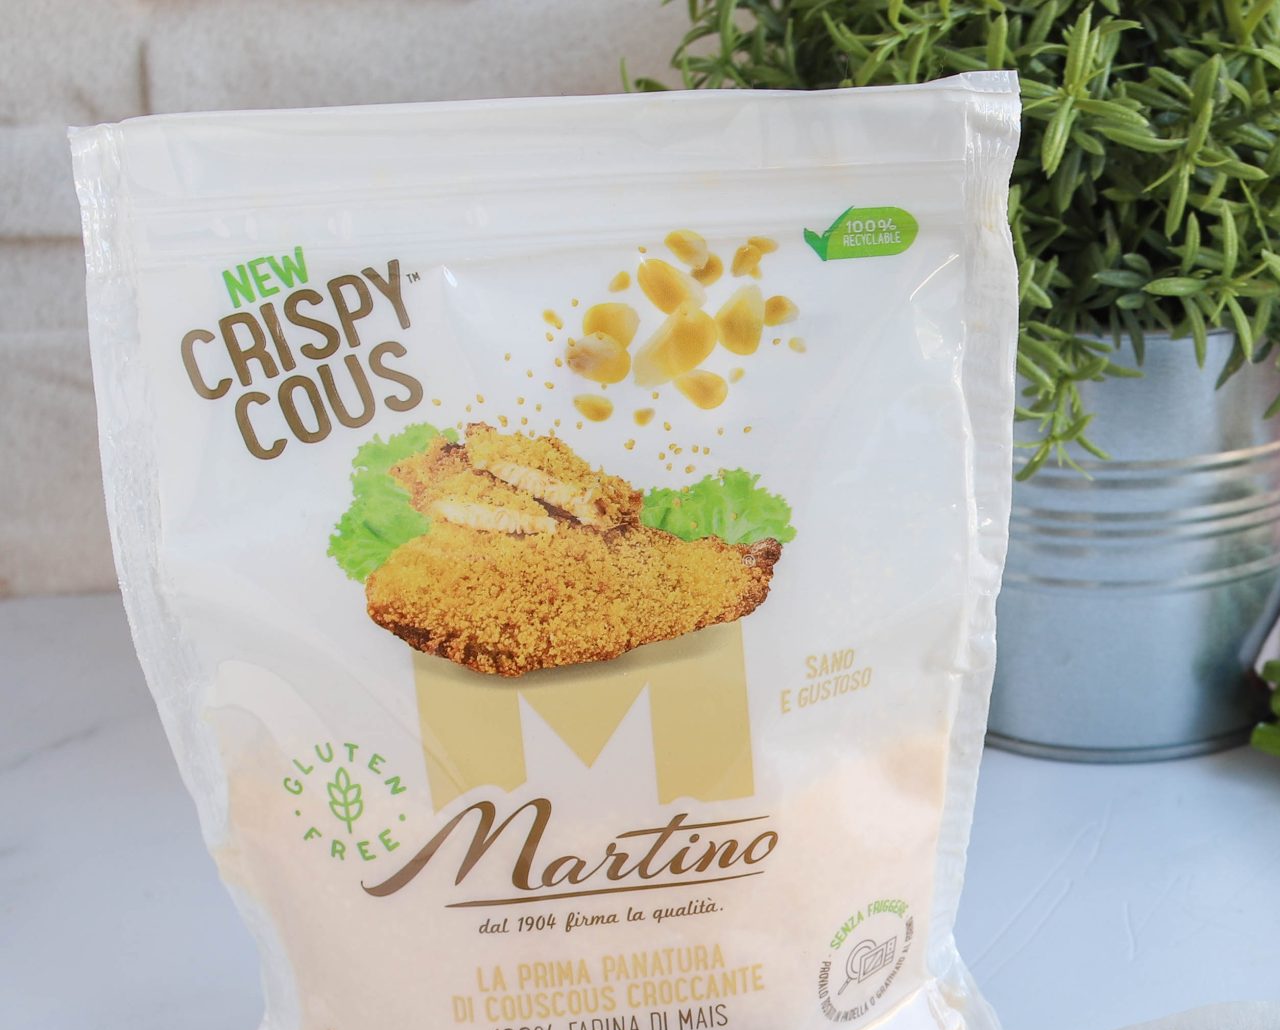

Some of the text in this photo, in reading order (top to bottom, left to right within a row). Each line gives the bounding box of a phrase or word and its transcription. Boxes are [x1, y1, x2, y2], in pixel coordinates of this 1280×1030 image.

[842, 231, 902, 247] RECYCLABLE
[846, 217, 897, 234] 100%
[222, 246, 309, 308] NEW
[235, 341, 424, 460] COUS
[805, 648, 855, 679] SANO
[781, 666, 873, 715] E GUSTOSO
[283, 742, 407, 796] GLUTEN
[303, 827, 401, 861] FREE
[361, 797, 779, 898] Martino
[478, 918, 509, 934] dal
[517, 913, 557, 932] 1904
[565, 911, 619, 932] firma
[627, 907, 645, 922] la
[830, 910, 864, 950] SENZA
[476, 943, 725, 993] LA PRIMA PANATURA
[452, 963, 765, 1023] DI COUSCOUS CROCCANTE
[679, 1004, 729, 1030] MAIS
